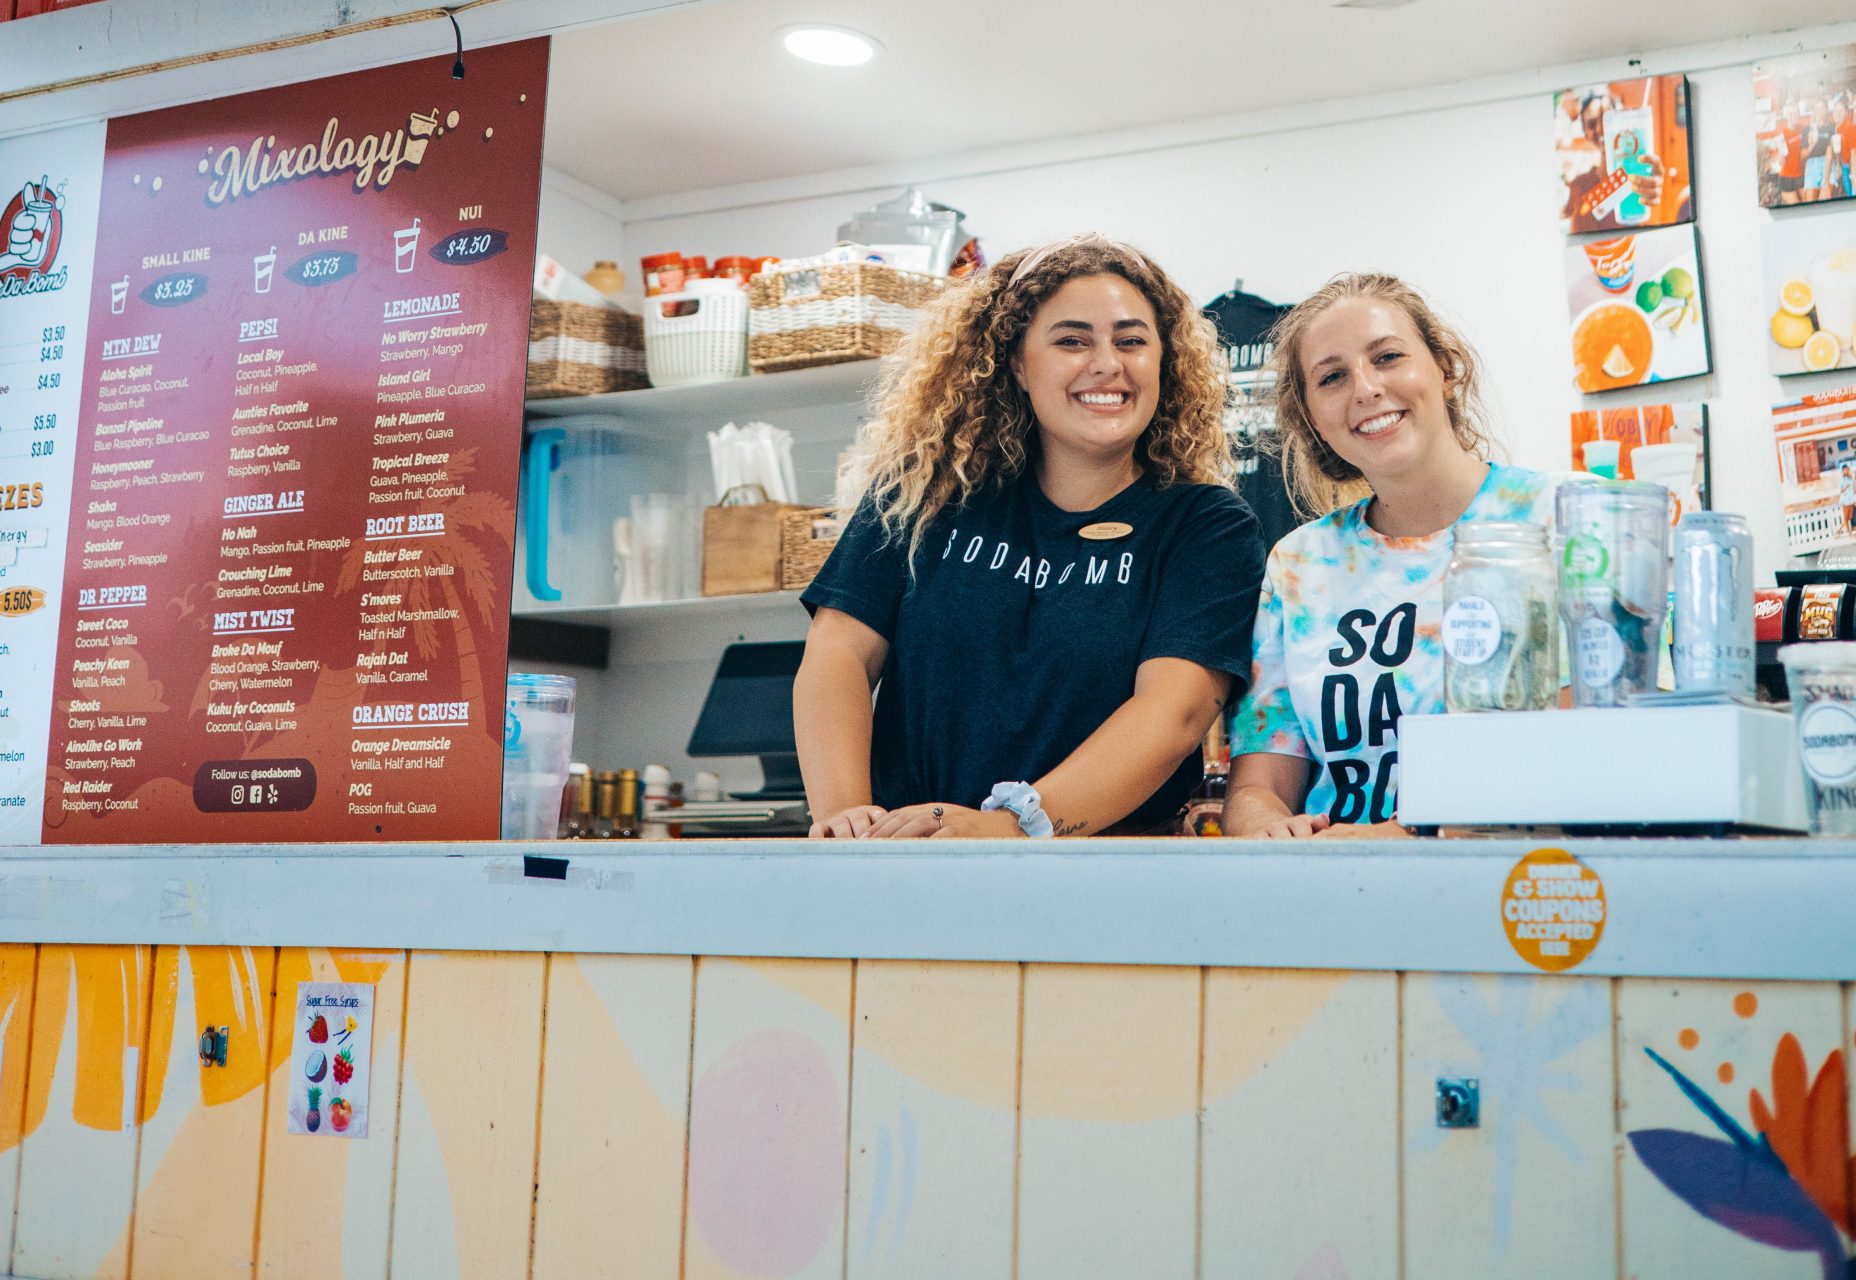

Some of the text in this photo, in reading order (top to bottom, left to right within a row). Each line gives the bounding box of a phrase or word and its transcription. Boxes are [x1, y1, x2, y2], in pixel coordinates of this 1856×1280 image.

[207, 117, 406, 204] Mixology
[459, 205, 482, 221] NUI
[298, 226, 349, 246] DA KINE
[446, 233, 491, 257] $4.50
[142, 247, 211, 270] SMALL KINE
[384, 292, 461, 318] LEMONADE
[42, 325, 65, 343] $3.50
[239, 318, 278, 338] PEPSI
[381, 322, 488, 345] No Worry Strawberry
[102, 334, 161, 356] MTN DEW
[432, 343, 464, 357] Mango
[40, 345, 63, 364] $4.50
[237, 348, 284, 365] Local Boy
[100, 364, 152, 381] Aloha Spirit
[378, 368, 431, 387] Island Girl
[37, 372, 61, 391] $4.50
[235, 384, 253, 396] Half
[261, 381, 278, 394] Half
[99, 386, 117, 397] Blue
[425, 382, 486, 399] Blue Curacao
[98, 398, 145, 412] Passion fruit
[232, 400, 309, 421] Aunties Favorite
[33, 413, 56, 431] $5.50
[95, 418, 164, 436] Banzai Pipeline
[316, 415, 338, 428] Lime
[374, 409, 445, 429] Pink Plumeria
[94, 430, 209, 452] Blue Blue Curacao
[425, 428, 454, 440] Guava
[31, 439, 54, 458] $3.00
[230, 443, 290, 460] Tutus Choice
[91, 459, 154, 475] Honeymooner
[272, 459, 301, 472] Vanilla
[372, 452, 450, 471] Tropical Breeze
[160, 470, 205, 484] Strawberry
[224, 490, 305, 513] GINGER ALE
[368, 484, 465, 504] Passion Coconut
[88, 500, 117, 514] Shaka
[116, 513, 171, 527] Blood Orange
[365, 513, 445, 536] ROOT BEER
[222, 525, 257, 541] Ho Nah
[84, 539, 124, 553] Seasider
[252, 536, 351, 555] Passion Pineapple
[128, 552, 168, 567] Pineapple
[364, 549, 423, 564] Butter Beer
[942, 528, 1134, 589] SODABOMB
[218, 565, 292, 582] Crouching Lime
[424, 564, 455, 577] Vanilla
[79, 585, 147, 605] DR PEPPER
[302, 580, 325, 593] Lime
[4, 590, 32, 611] 5.50$
[360, 592, 402, 607] S'mores
[76, 618, 128, 632] Sweet Coco
[213, 608, 295, 630] MIST TWIST
[360, 612, 396, 624] Toasted
[112, 634, 137, 645] Vanilla
[358, 627, 407, 641] Half n Half
[1328, 601, 1417, 668] SO
[212, 641, 284, 658] Broke Da Mouf
[73, 658, 130, 673] Peachy Keen
[210, 662, 236, 675] Blood
[356, 651, 409, 669] Rajah Dat
[101, 675, 125, 687] Peach
[240, 676, 293, 689] Watermelon
[389, 669, 428, 683] Caramel
[69, 700, 100, 712] Shoots
[207, 700, 296, 718] Kuku for Coconuts
[352, 702, 470, 724] ORANGE CRUSH
[1321, 672, 1403, 753] DA
[126, 715, 147, 727] Lime
[275, 718, 297, 731] Lime
[103, 739, 116, 752] Go
[118, 738, 143, 751] Work
[351, 737, 451, 755] Orange Dreamsicle
[111, 756, 136, 768] Peach
[385, 755, 445, 770] Half and Half
[211, 767, 302, 780] Follow us: @sodabomb
[63, 781, 113, 793] Red Raider
[348, 783, 373, 797] POG
[104, 799, 138, 810] Coconut
[348, 801, 437, 814] Passion Guava
[1536, 879, 1600, 898] SHOW
[1504, 898, 1604, 922] COUPONS
[1516, 922, 1596, 940] ACCEPTED
[325, 995, 338, 1006] Free
[340, 996, 359, 1008] Syrups
